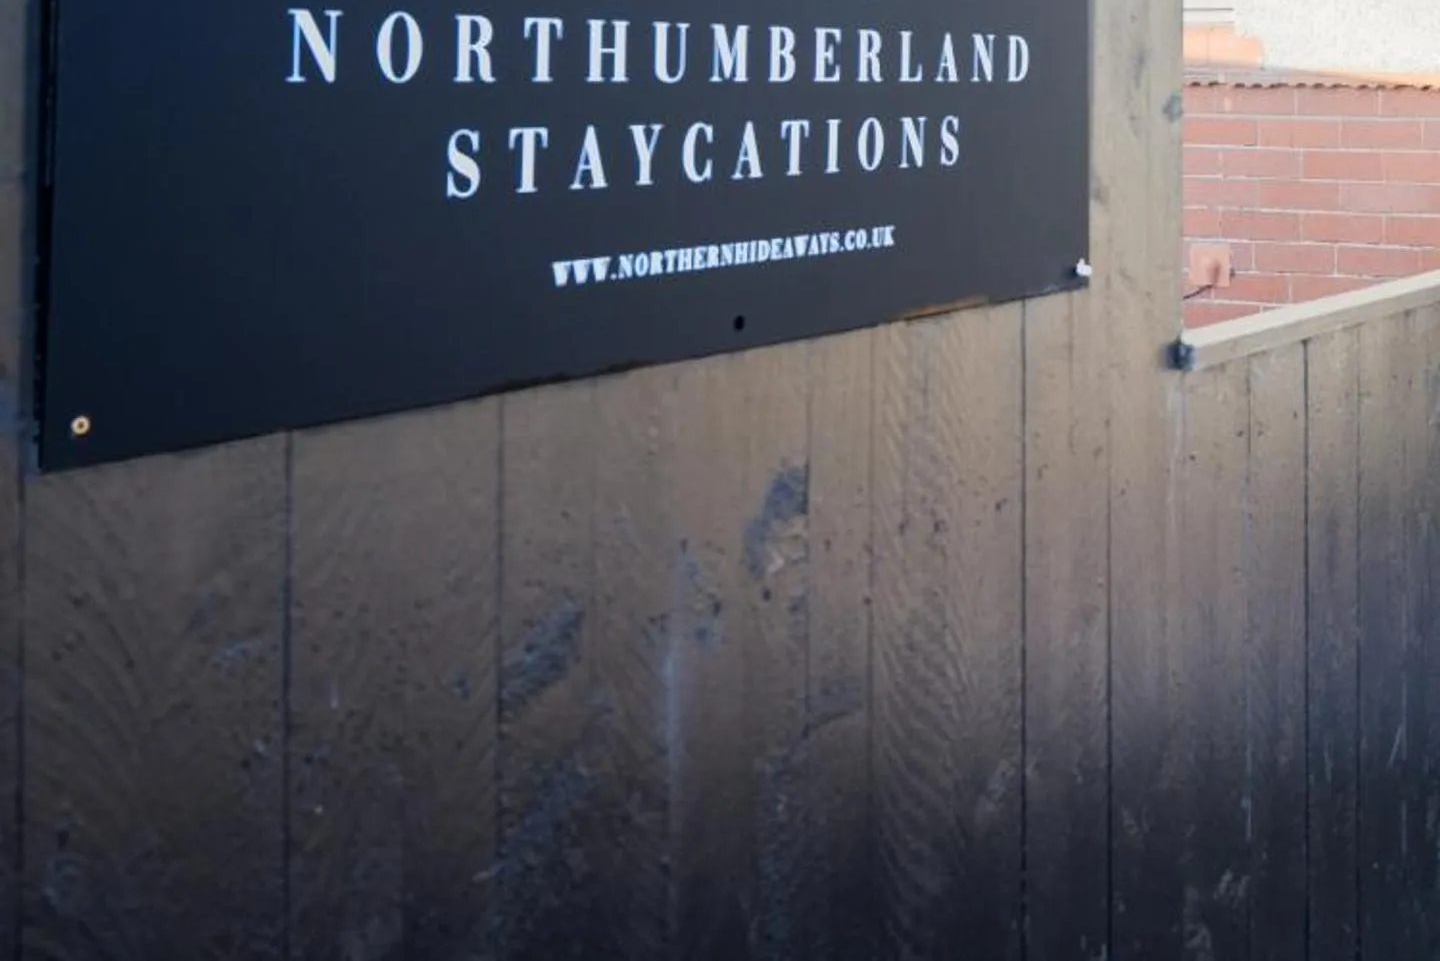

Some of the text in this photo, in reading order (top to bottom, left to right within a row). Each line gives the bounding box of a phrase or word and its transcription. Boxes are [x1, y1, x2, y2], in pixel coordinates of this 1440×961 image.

[287, 9, 1030, 83] NORTHUMBERLAND
[447, 115, 960, 198] STAYCATIONS
[552, 225, 895, 286] WWW.NORTHERNHIDEAWAYS.CO.UK
